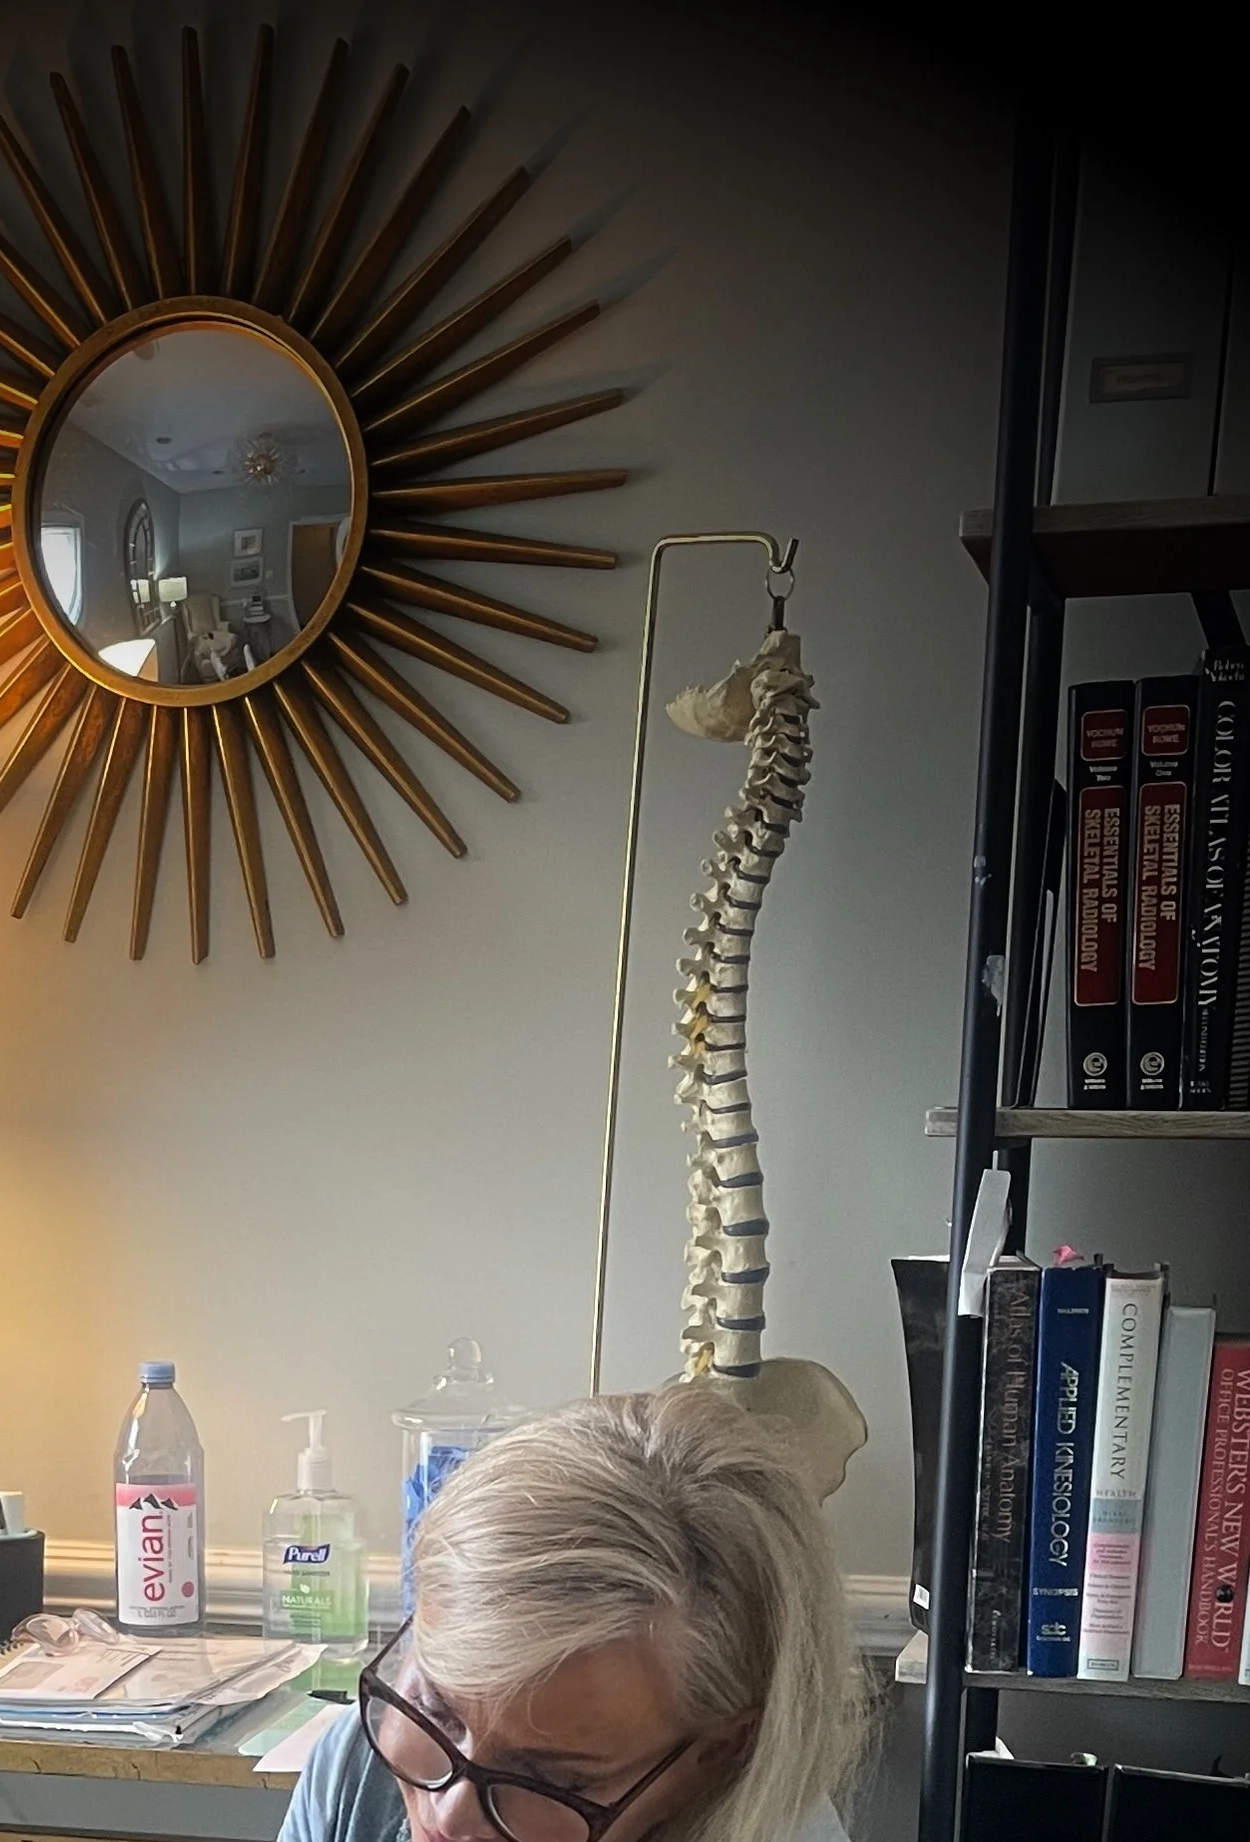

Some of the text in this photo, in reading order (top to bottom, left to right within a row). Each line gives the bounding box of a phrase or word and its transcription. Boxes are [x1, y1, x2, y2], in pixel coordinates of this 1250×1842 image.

[1081, 809, 1101, 971] SKELETAL RADIOLOGY
[1101, 808, 1120, 923] ESSENTIALS OF
[1138, 806, 1161, 970] SKELETAL RADIOLOGY
[1159, 804, 1181, 921] ESSENTIALS OF
[1197, 701, 1235, 1006] COLOR ATLAS OF ANATOMY
[991, 1294, 1031, 1545] Atlas of Human Anatomy
[1110, 1302, 1138, 1481] COMPLEMENTARY
[1217, 1368, 1234, 1424] OFFICE
[1228, 1369, 1250, 1494] WEBSTER'S
[1048, 1362, 1079, 1568] APPLIED KINESIOLOGY
[1203, 1429, 1228, 1552] PROFESSIONAL'S
[140, 1514, 166, 1602] evian
[289, 1547, 327, 1562] Purell
[1222, 1502, 1244, 1558] NEW
[282, 1595, 331, 1607] NATURALS
[1032, 1587, 1079, 1597] SYNOPSIS
[1193, 1554, 1218, 1647] HANDBOOK
